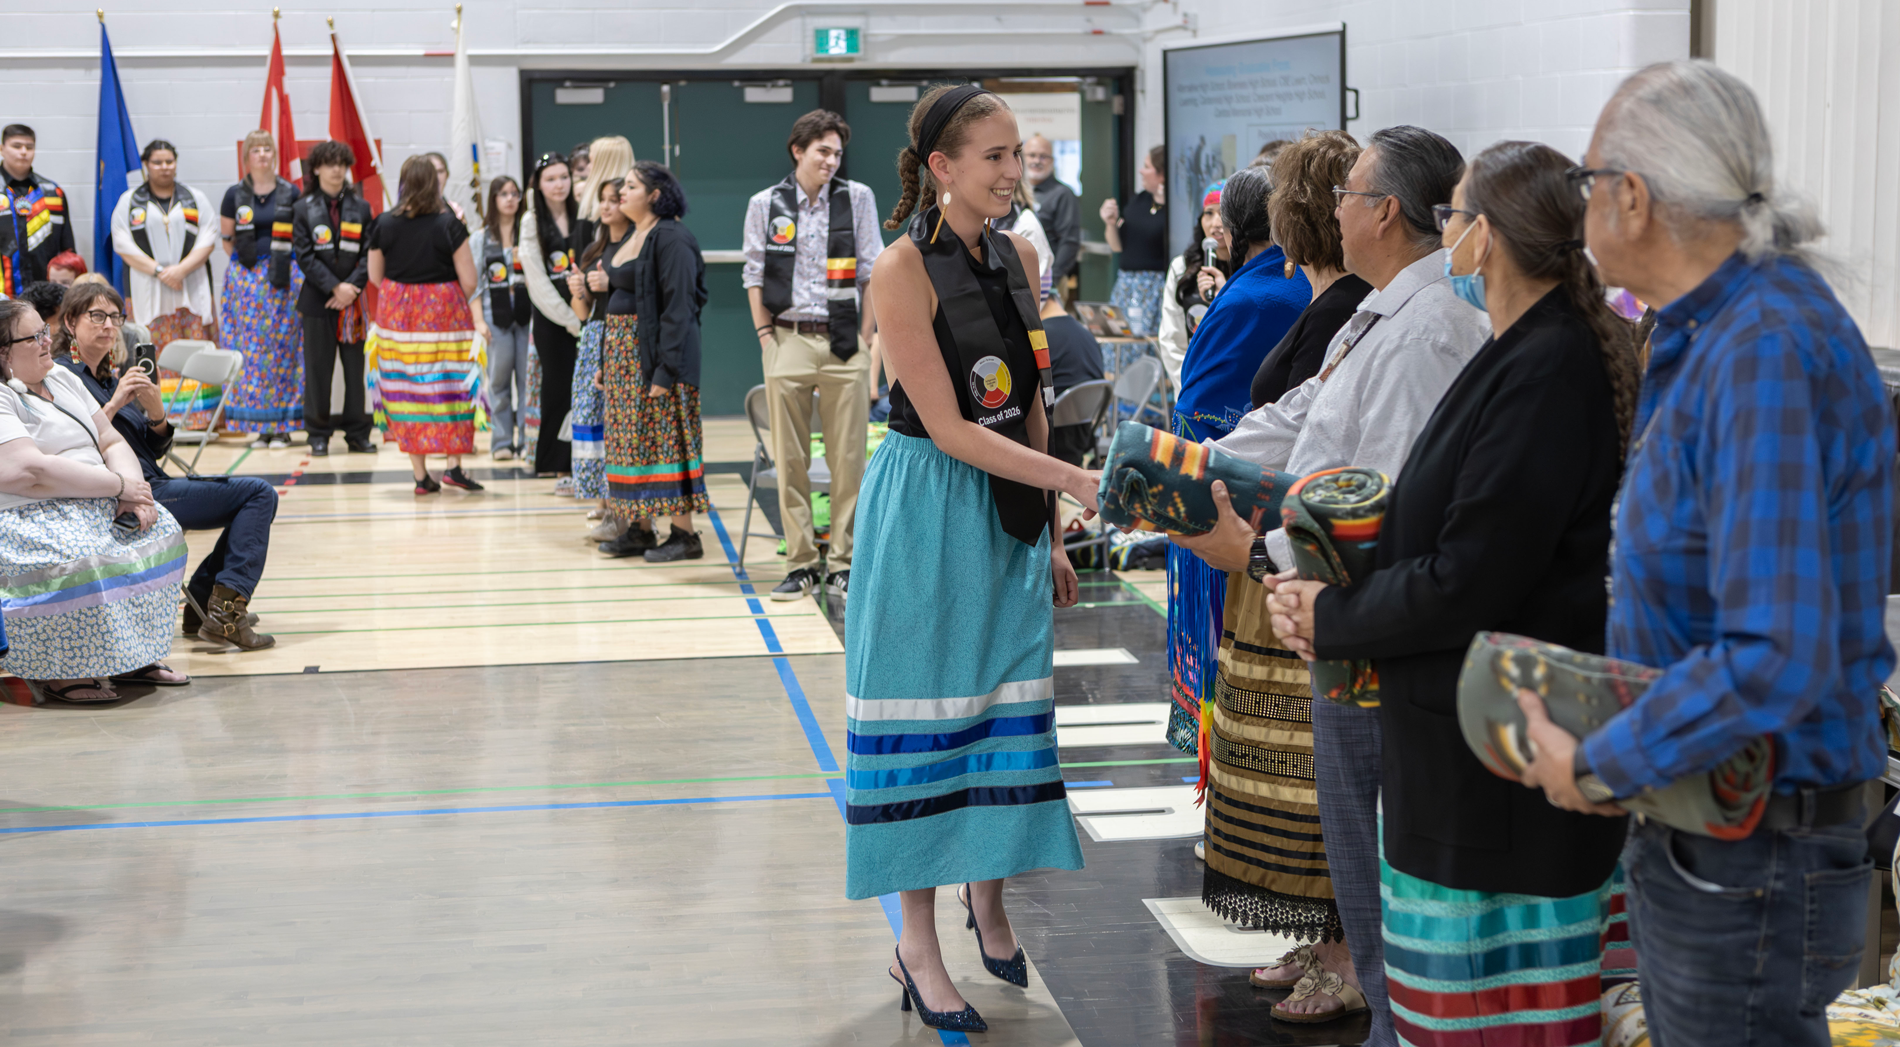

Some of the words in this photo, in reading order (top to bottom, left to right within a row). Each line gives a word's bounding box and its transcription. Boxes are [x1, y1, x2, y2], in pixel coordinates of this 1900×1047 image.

[978, 415, 997, 427] Class
[997, 410, 1004, 421] of
[1004, 406, 1021, 419] 2026
